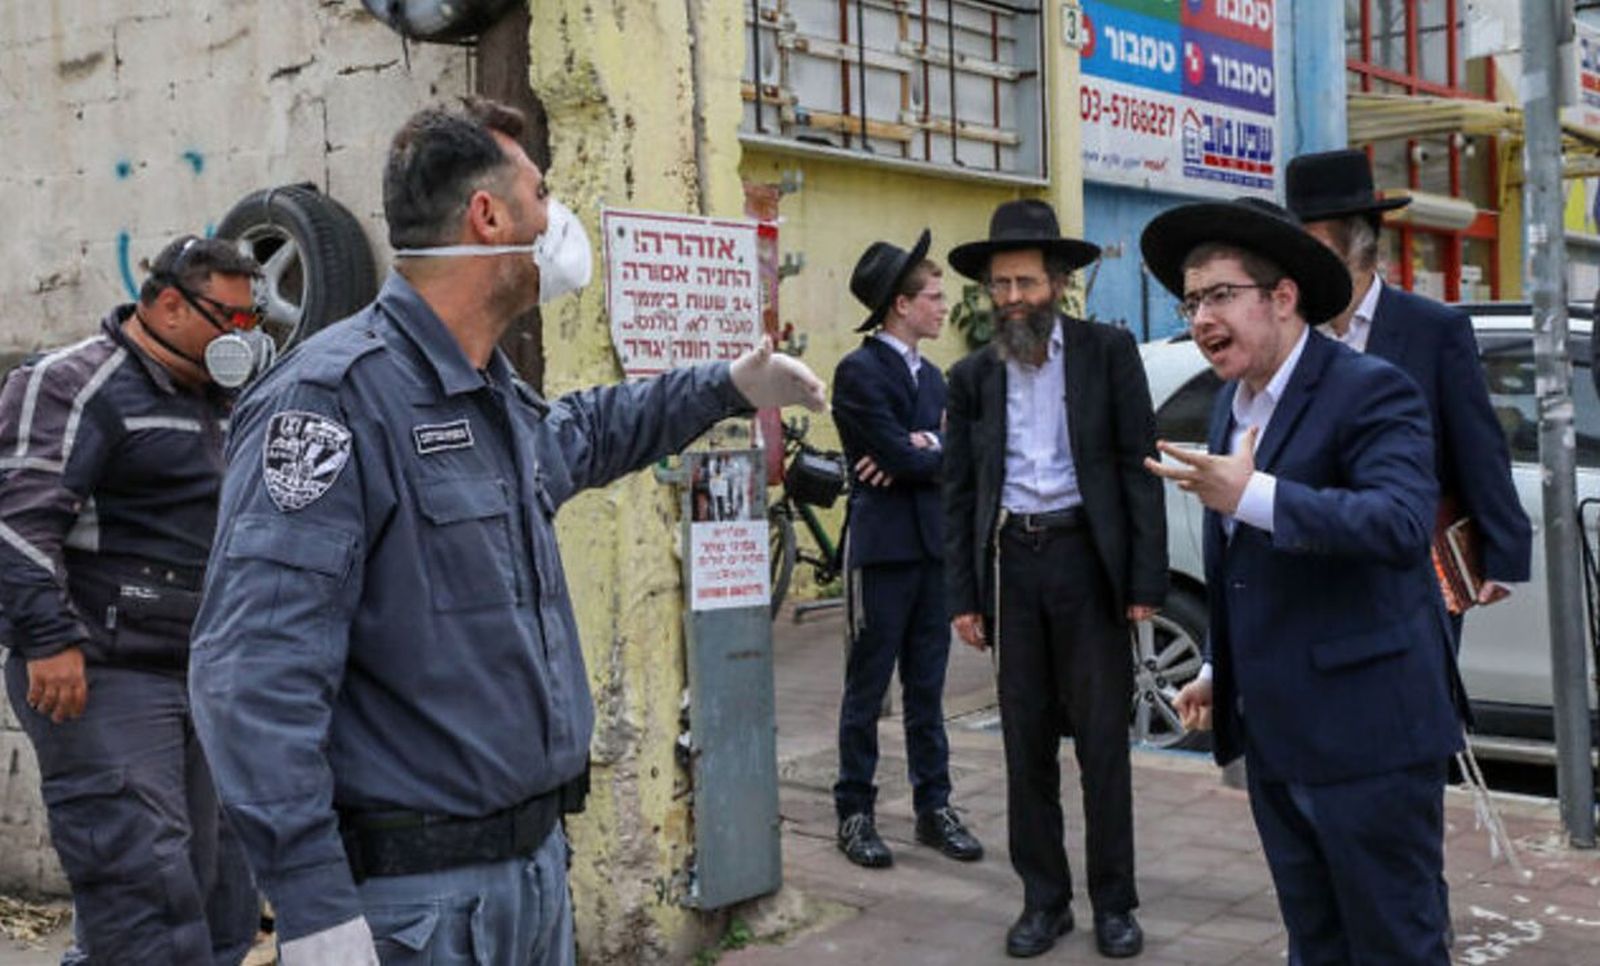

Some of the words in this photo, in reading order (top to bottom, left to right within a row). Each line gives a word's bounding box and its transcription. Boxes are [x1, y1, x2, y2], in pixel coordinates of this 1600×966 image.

[633, 230, 735, 261] אזהרה!
[622, 261, 688, 283] אסורה
[697, 266, 751, 288] החניה
[673, 339, 711, 359] חונה
